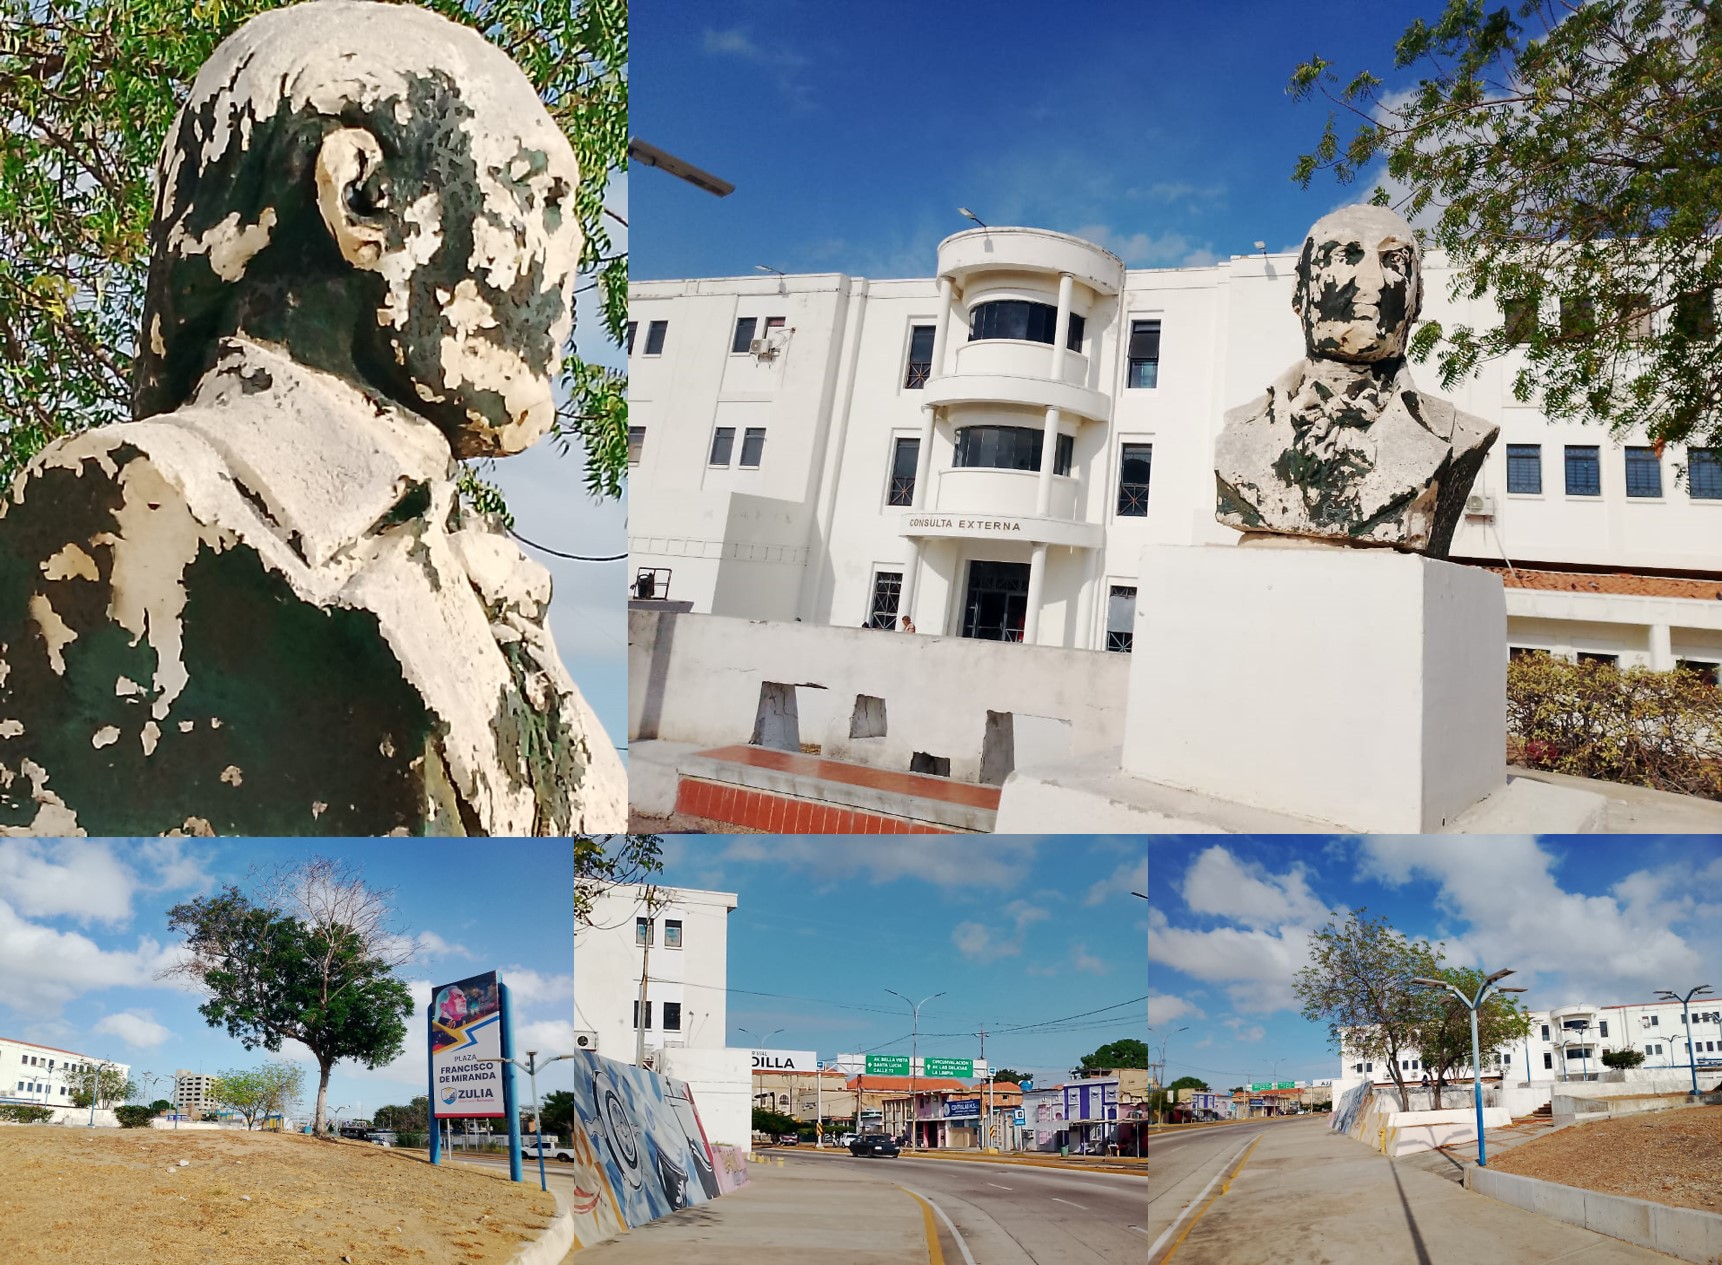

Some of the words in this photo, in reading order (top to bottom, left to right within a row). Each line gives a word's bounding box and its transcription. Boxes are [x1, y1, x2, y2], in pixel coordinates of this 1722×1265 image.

[909, 518, 952, 528] CONSULTA
[958, 519, 1021, 531] EXTERNA
[454, 1054, 477, 1062] PLAZA
[440, 1062, 494, 1074] FRANCISCO
[439, 1075, 450, 1083] DE
[451, 1071, 496, 1082] MIRANDA
[458, 1088, 494, 1099] ZULIA
